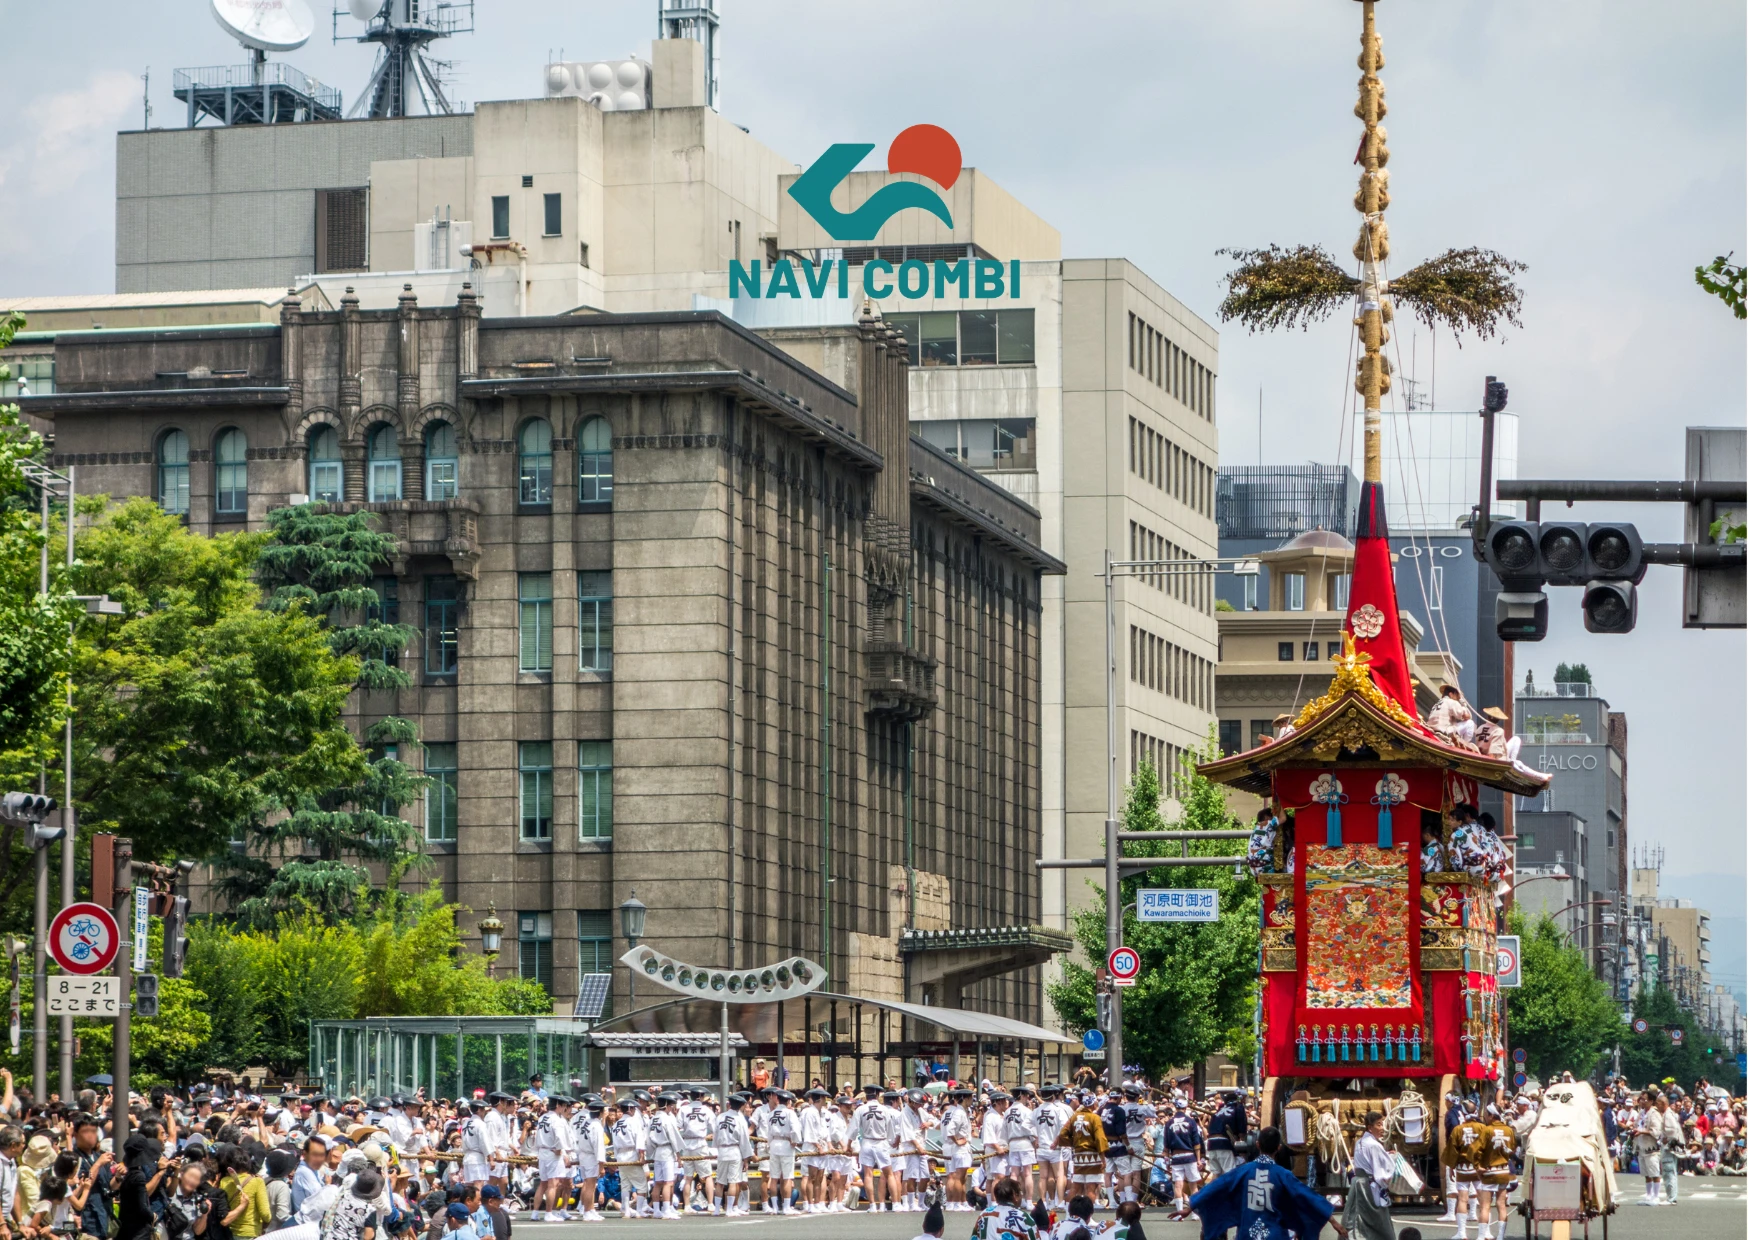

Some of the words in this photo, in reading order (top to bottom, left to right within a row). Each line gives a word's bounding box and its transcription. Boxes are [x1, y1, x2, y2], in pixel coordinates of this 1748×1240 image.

[1538, 754, 1597, 770] FALCO
[1142, 893, 1213, 908] 河原町御池
[1144, 909, 1211, 917] Kawaramachioike
[1116, 956, 1133, 970] 50
[50, 998, 116, 1011] ここまで
